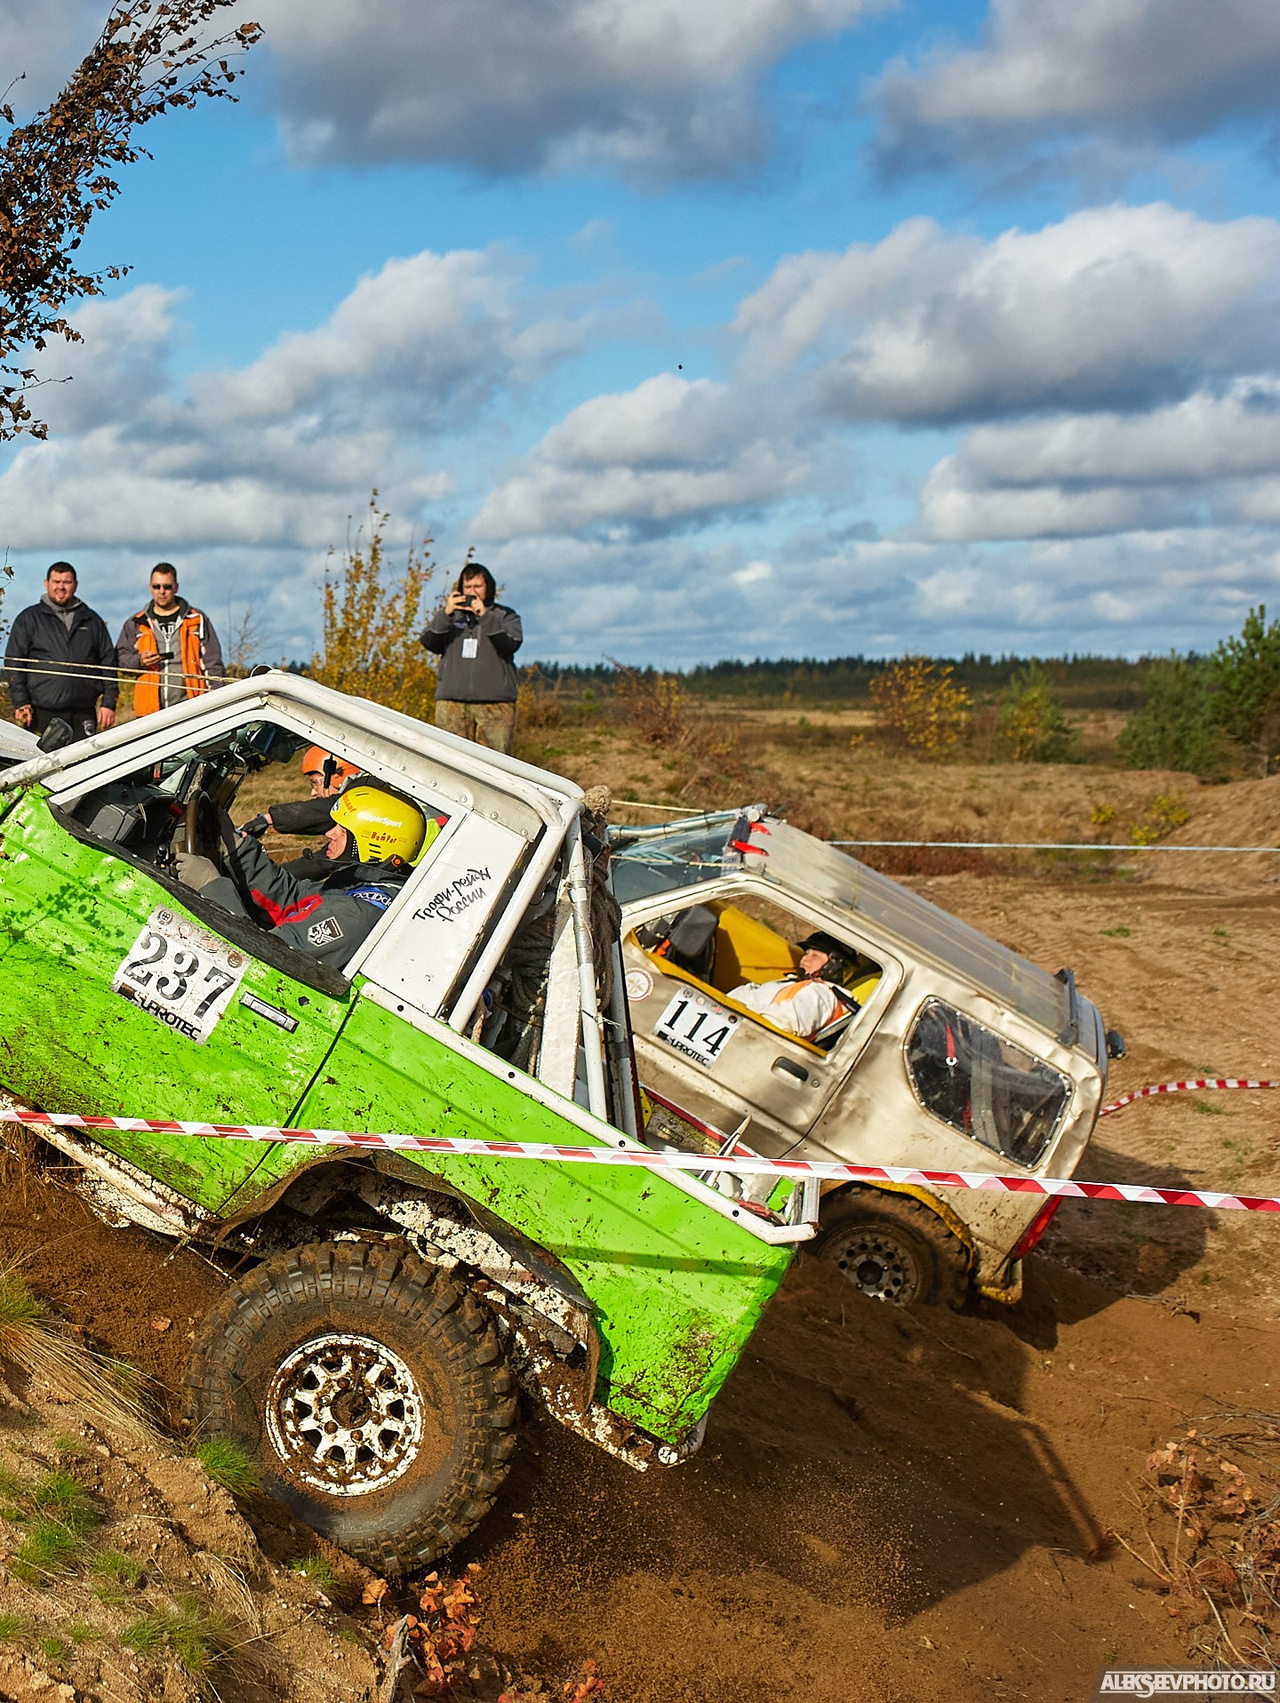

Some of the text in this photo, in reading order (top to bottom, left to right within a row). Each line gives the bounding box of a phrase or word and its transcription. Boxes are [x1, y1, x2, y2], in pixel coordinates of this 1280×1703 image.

[436, 887, 487, 922] России
[123, 932, 236, 1019] 237
[133, 991, 202, 1041] SUPROTEC
[664, 1000, 730, 1057] 114
[665, 1035, 710, 1066] SUPROTEC
